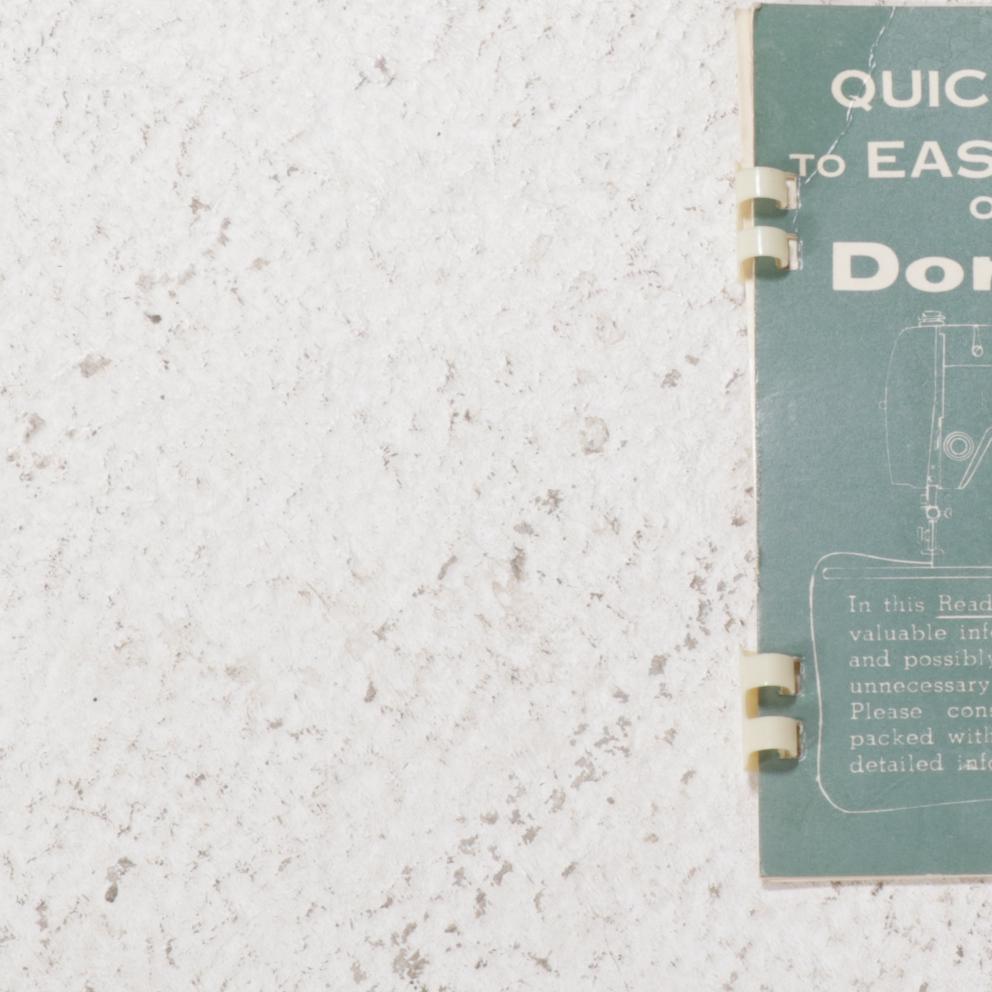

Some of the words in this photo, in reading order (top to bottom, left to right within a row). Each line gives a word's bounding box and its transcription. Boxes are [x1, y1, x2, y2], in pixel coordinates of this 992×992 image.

[790, 153, 845, 178] TO
[848, 595, 871, 613] In
[884, 594, 926, 613] this
[849, 623, 948, 642] valuable
[849, 648, 891, 668] and
[850, 679, 990, 695] unnecessary
[851, 702, 922, 721] Please
[850, 727, 934, 749] packed
[849, 753, 943, 774] detailed
